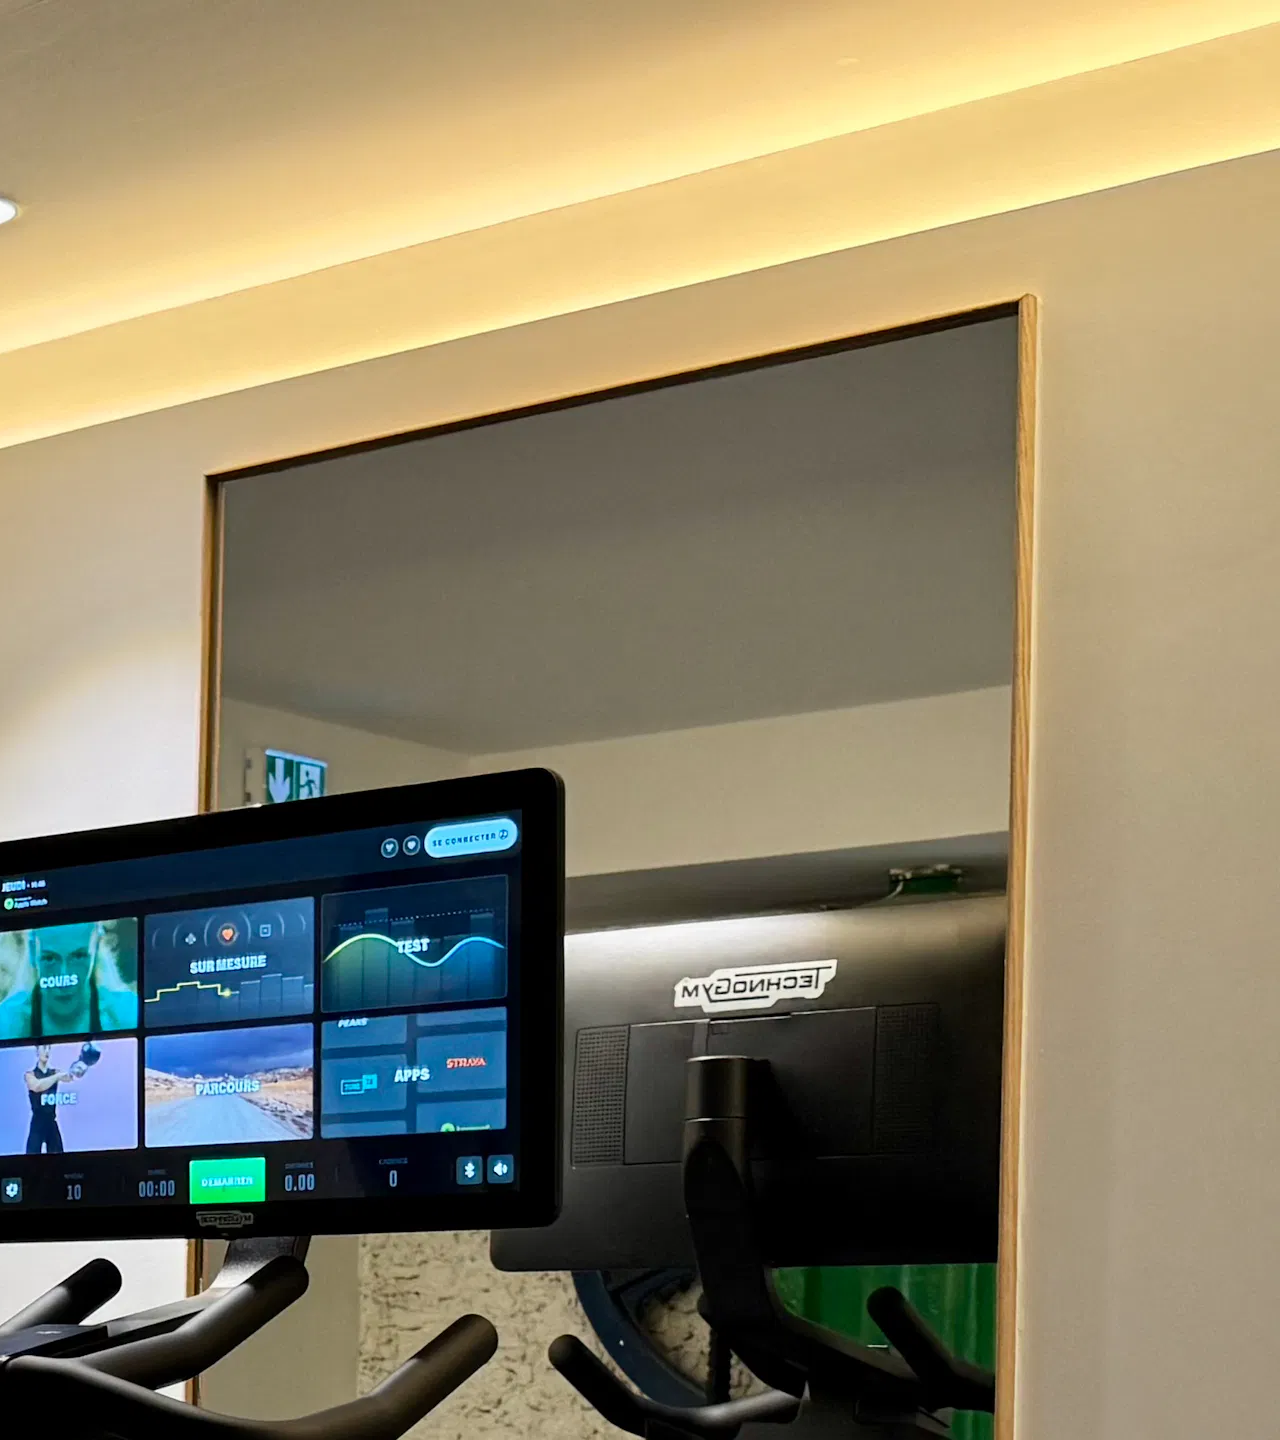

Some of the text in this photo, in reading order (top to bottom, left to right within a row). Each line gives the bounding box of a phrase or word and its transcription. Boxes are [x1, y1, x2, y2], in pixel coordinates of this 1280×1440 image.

[396, 937, 430, 953] TEST
[190, 954, 267, 974] SUR MESURE
[40, 974, 78, 989] COURS
[446, 1057, 487, 1069] STRAVA
[394, 1067, 431, 1083] APPS
[195, 1079, 261, 1096] PARCOURS
[41, 1092, 77, 1107] FORCE
[284, 1173, 316, 1192] 0.00
[389, 1170, 398, 1187] 0
[66, 1184, 82, 1200] 10
[138, 1180, 175, 1197] 00:00
